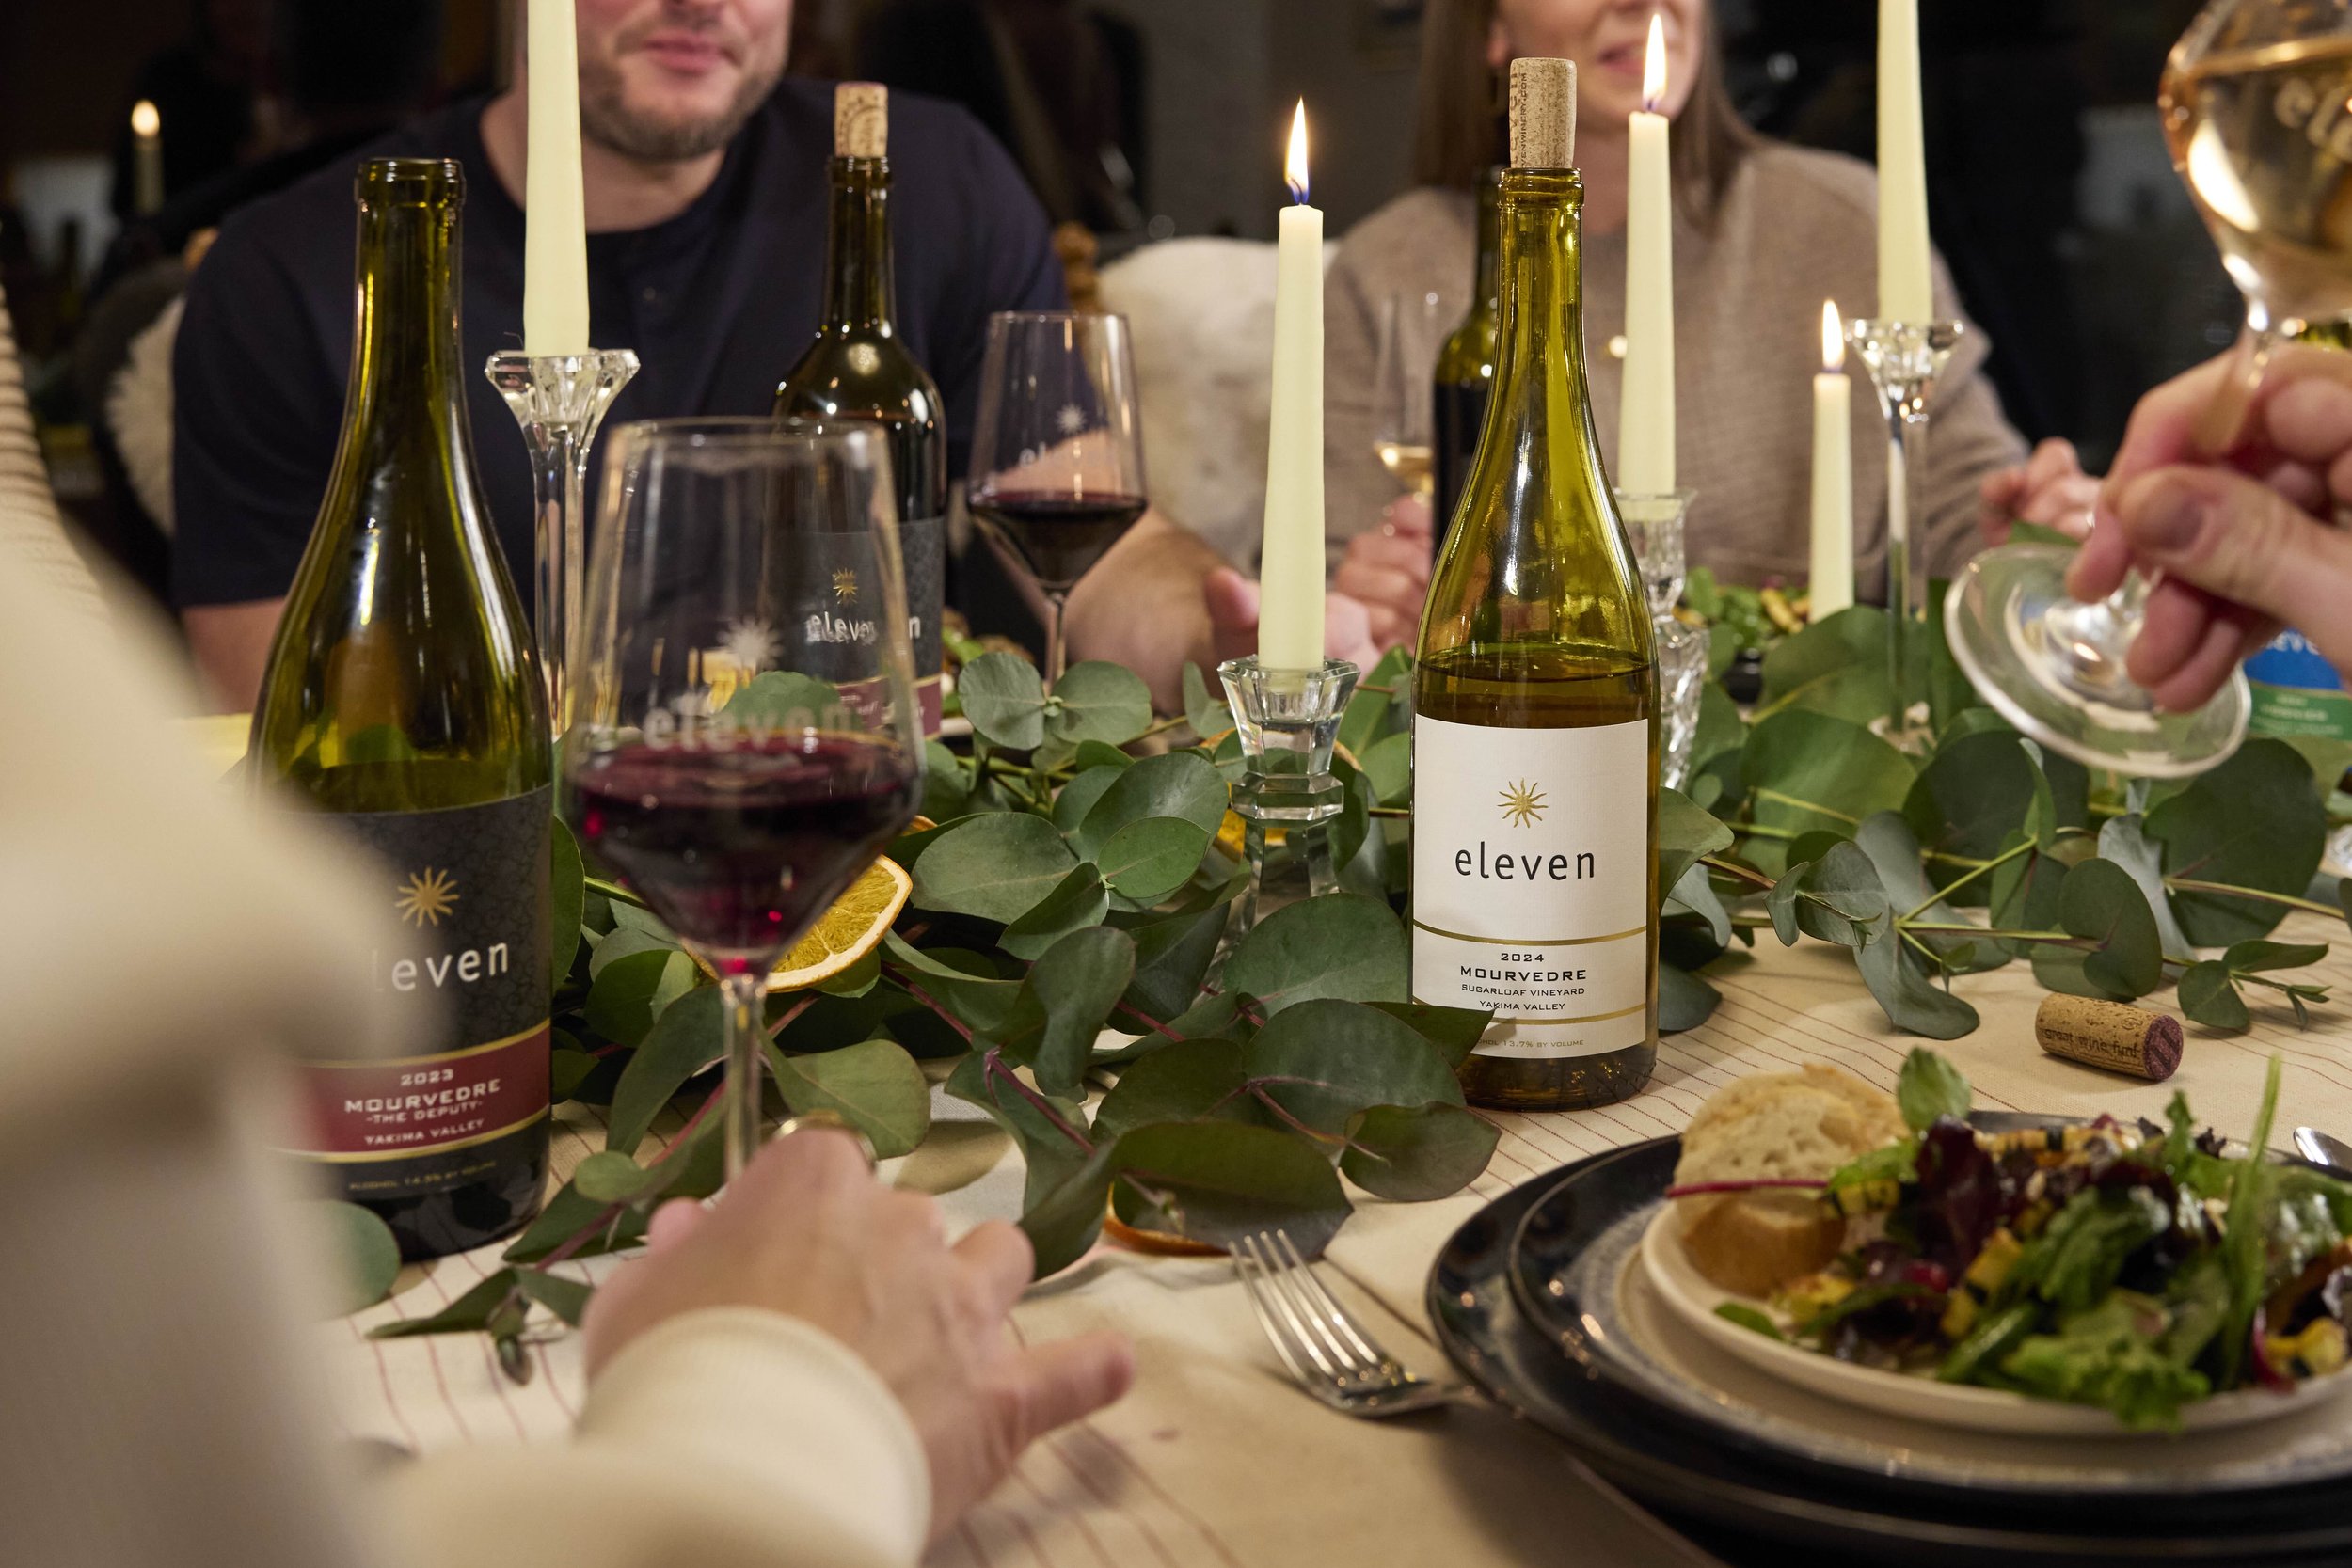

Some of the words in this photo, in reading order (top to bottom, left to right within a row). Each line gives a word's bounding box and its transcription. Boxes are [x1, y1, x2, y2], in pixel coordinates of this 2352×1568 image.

[1455, 841, 1594, 880] eleven
[1501, 952, 1545, 963] 2024
[372, 942, 508, 992] leven
[1460, 965, 1587, 982] MOURVEDRE
[1461, 984, 1527, 997] SUGARLOAF
[1530, 988, 1585, 997] VINEYARD
[1479, 1000, 1520, 1010] YAKIMA
[1523, 1003, 1565, 1011] VALLEY
[1550, 1039, 1584, 1048] VOLUME
[400, 1068, 454, 1086] 2023
[344, 1078, 501, 1114] MOURVEDRE
[364, 1131, 425, 1146] YAKIMA
[429, 1118, 485, 1138] VALLEY
